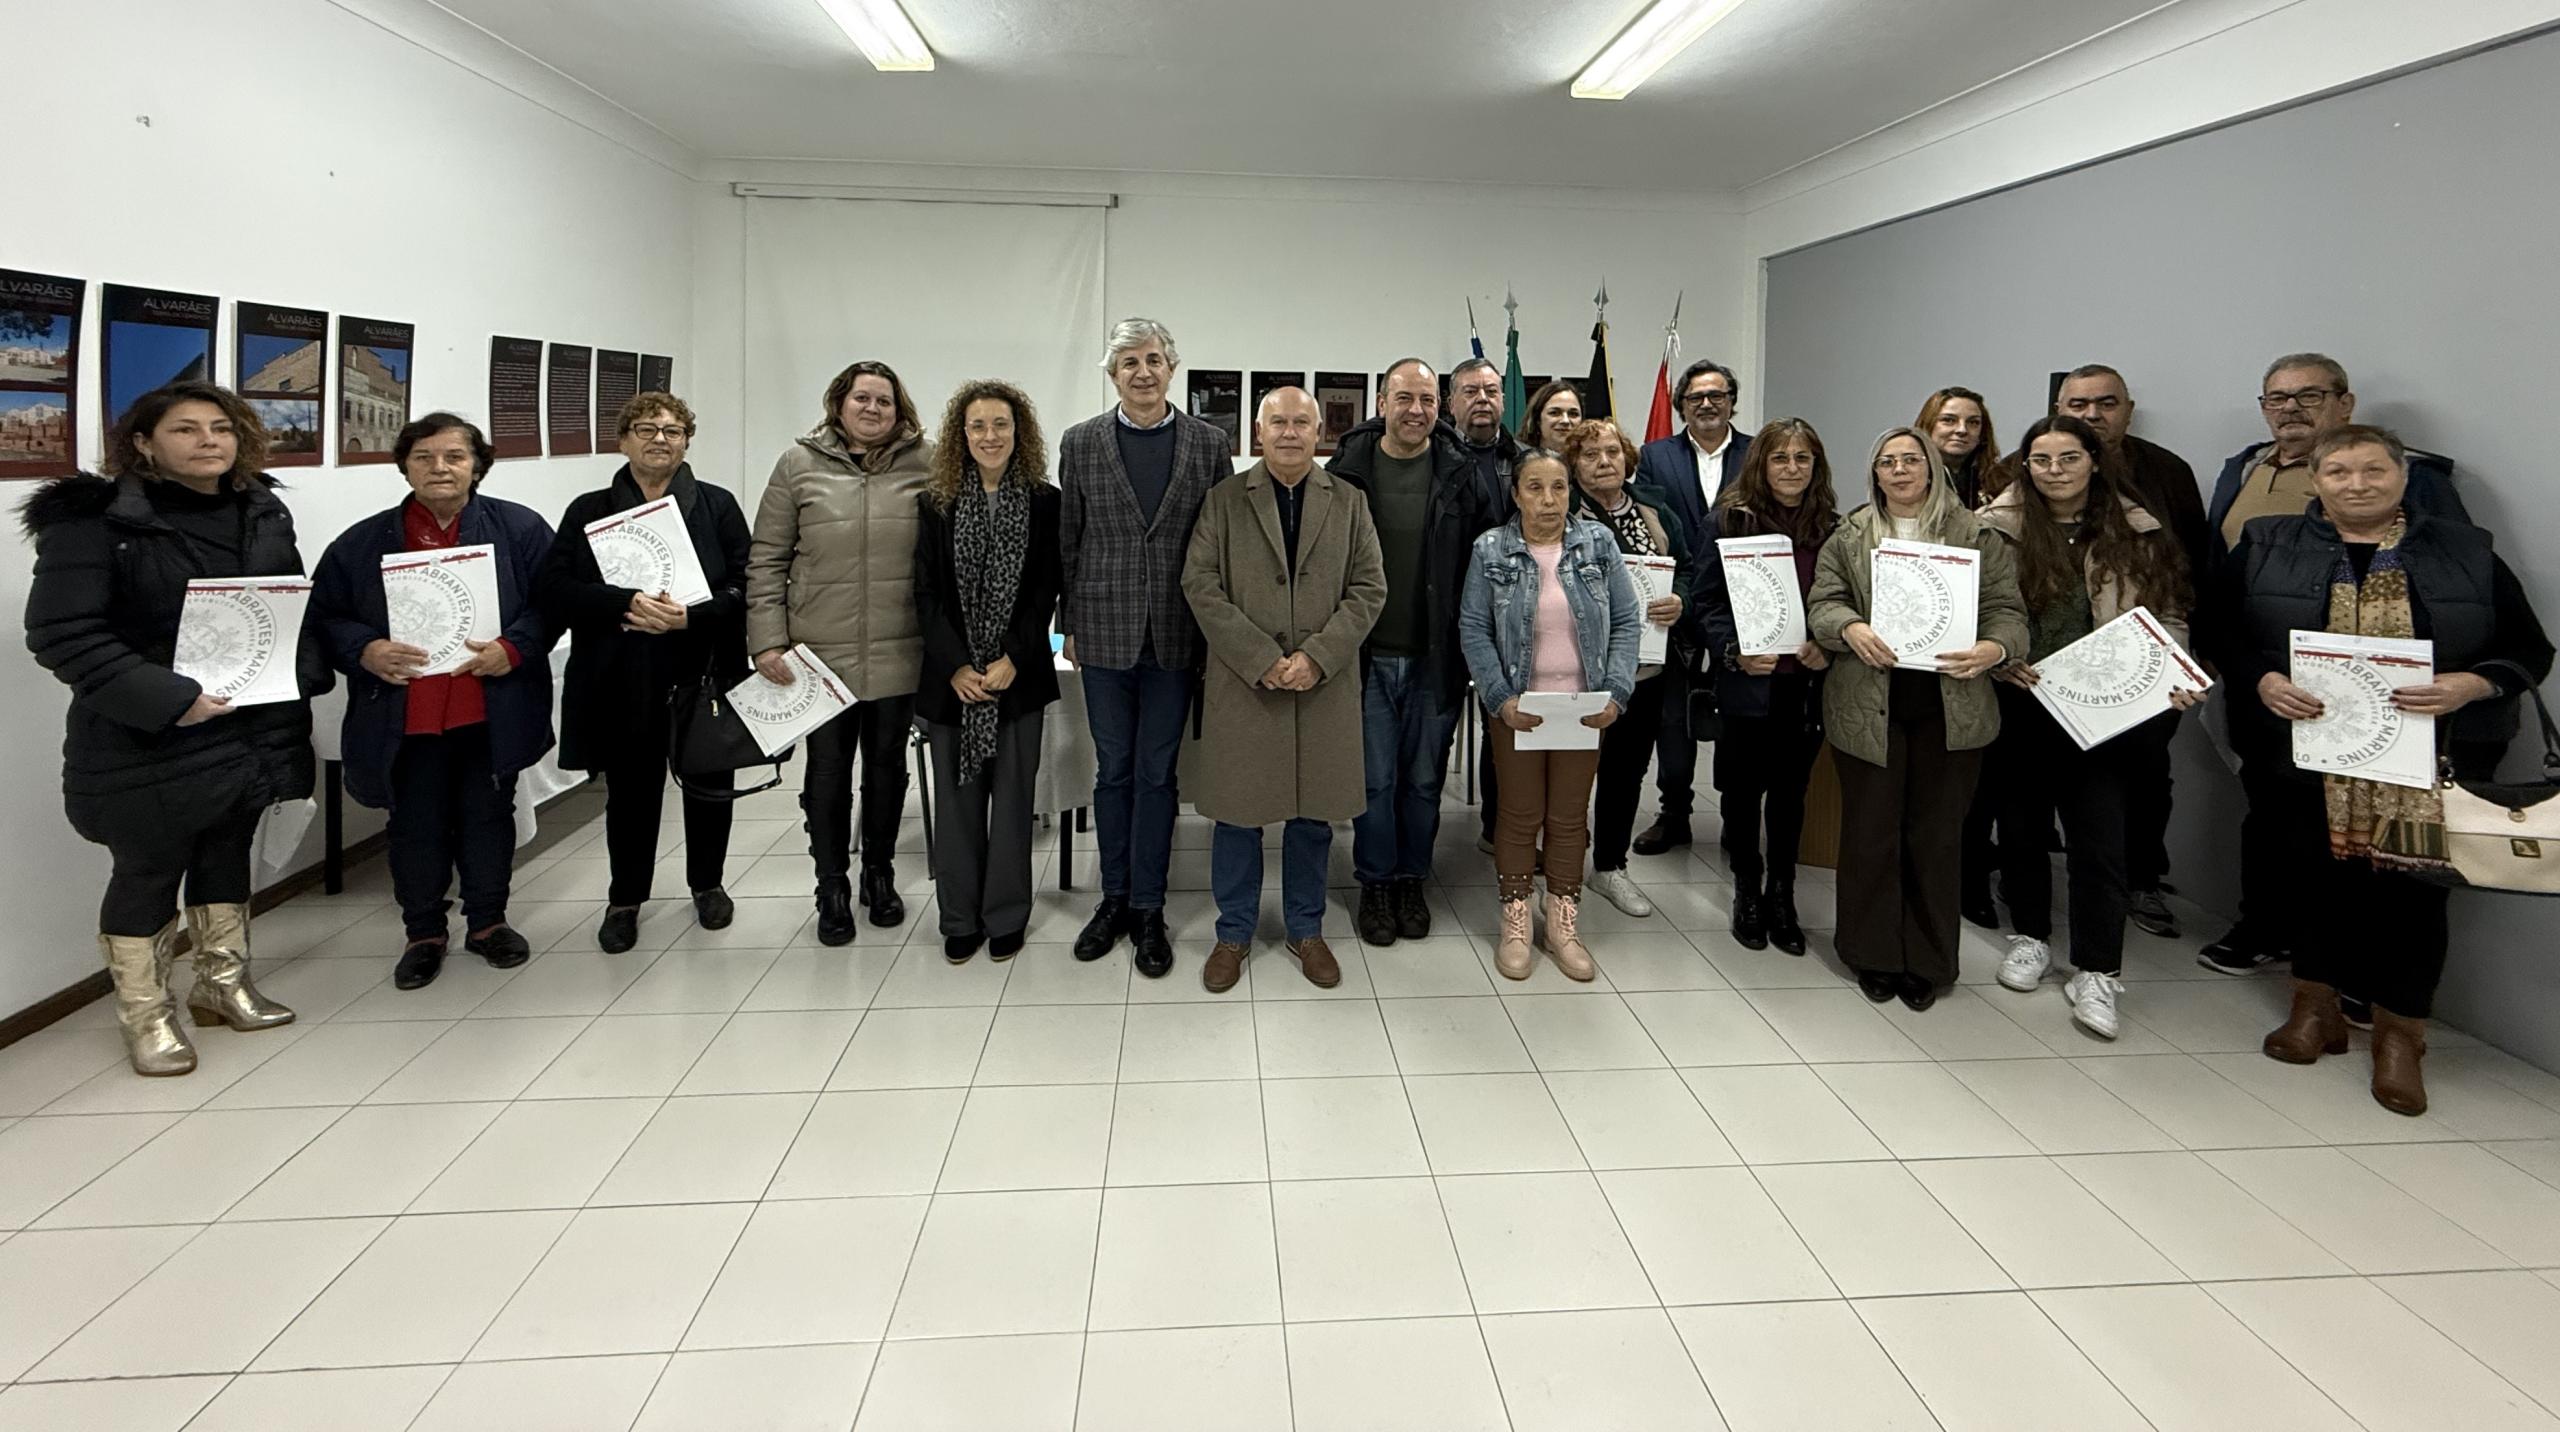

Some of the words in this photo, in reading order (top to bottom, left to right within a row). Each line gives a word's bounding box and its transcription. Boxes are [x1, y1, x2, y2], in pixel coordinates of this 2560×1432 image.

[0, 279, 74, 300] LVARÃES
[618, 524, 670, 561] ABRANTES
[420, 567, 472, 613] ABRANTES
[1629, 566, 1654, 600] ABRANT
[1750, 559, 1787, 609] ABRANTES
[1910, 559, 1950, 612] ABRANTES
[230, 592, 272, 646] ABRANTES
[431, 615, 471, 663] MARTINS
[1762, 607, 1787, 647] MARTINS
[1905, 614, 1949, 653] MARTINS
[216, 649, 267, 698] MARTINS
[2125, 642, 2161, 697] ABRANTES
[746, 705, 793, 722] MARTINS
[792, 670, 818, 715] ABRANTES
[2057, 686, 2123, 705] MARTINS
[2337, 724, 2396, 766] MARTINS
